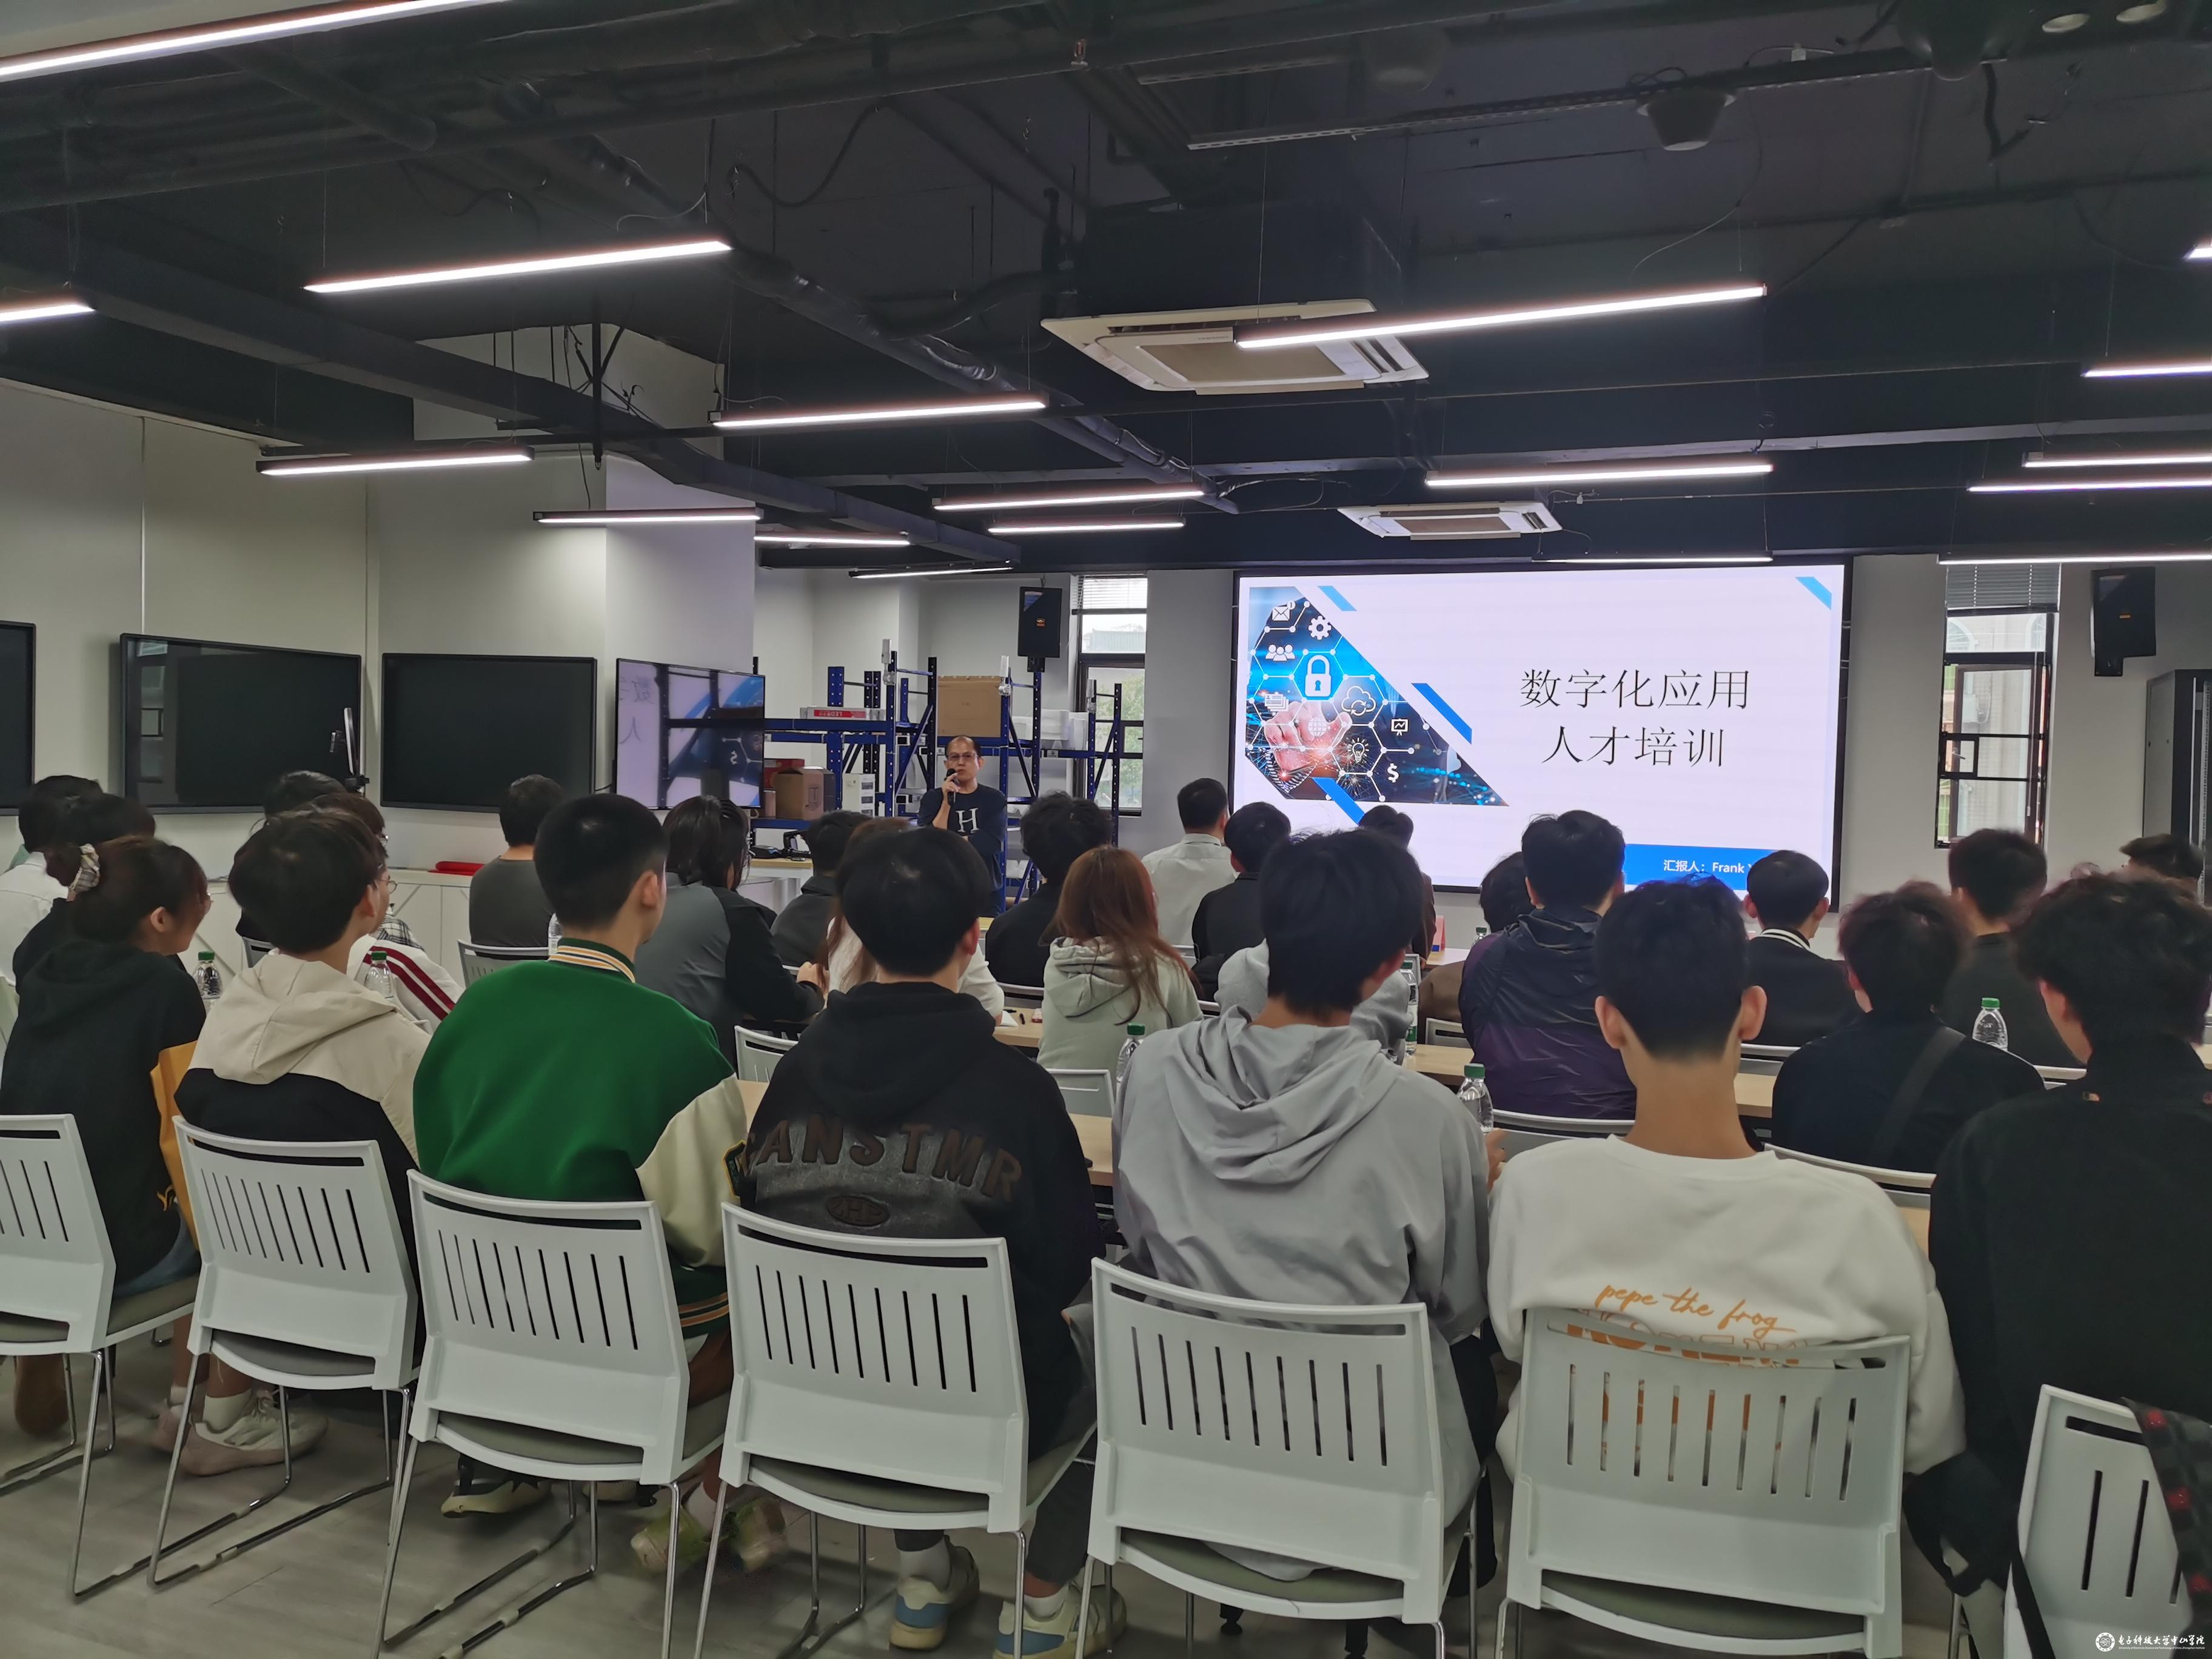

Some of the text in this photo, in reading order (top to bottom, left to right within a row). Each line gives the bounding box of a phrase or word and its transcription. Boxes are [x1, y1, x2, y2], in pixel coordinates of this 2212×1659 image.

[1518, 668, 1750, 710] 数字化应用
[1541, 725, 1726, 768] 人才培训
[956, 807, 980, 834] H
[1712, 861, 1744, 874] Frank
[1594, 1284, 1798, 1339] pepe the frog
